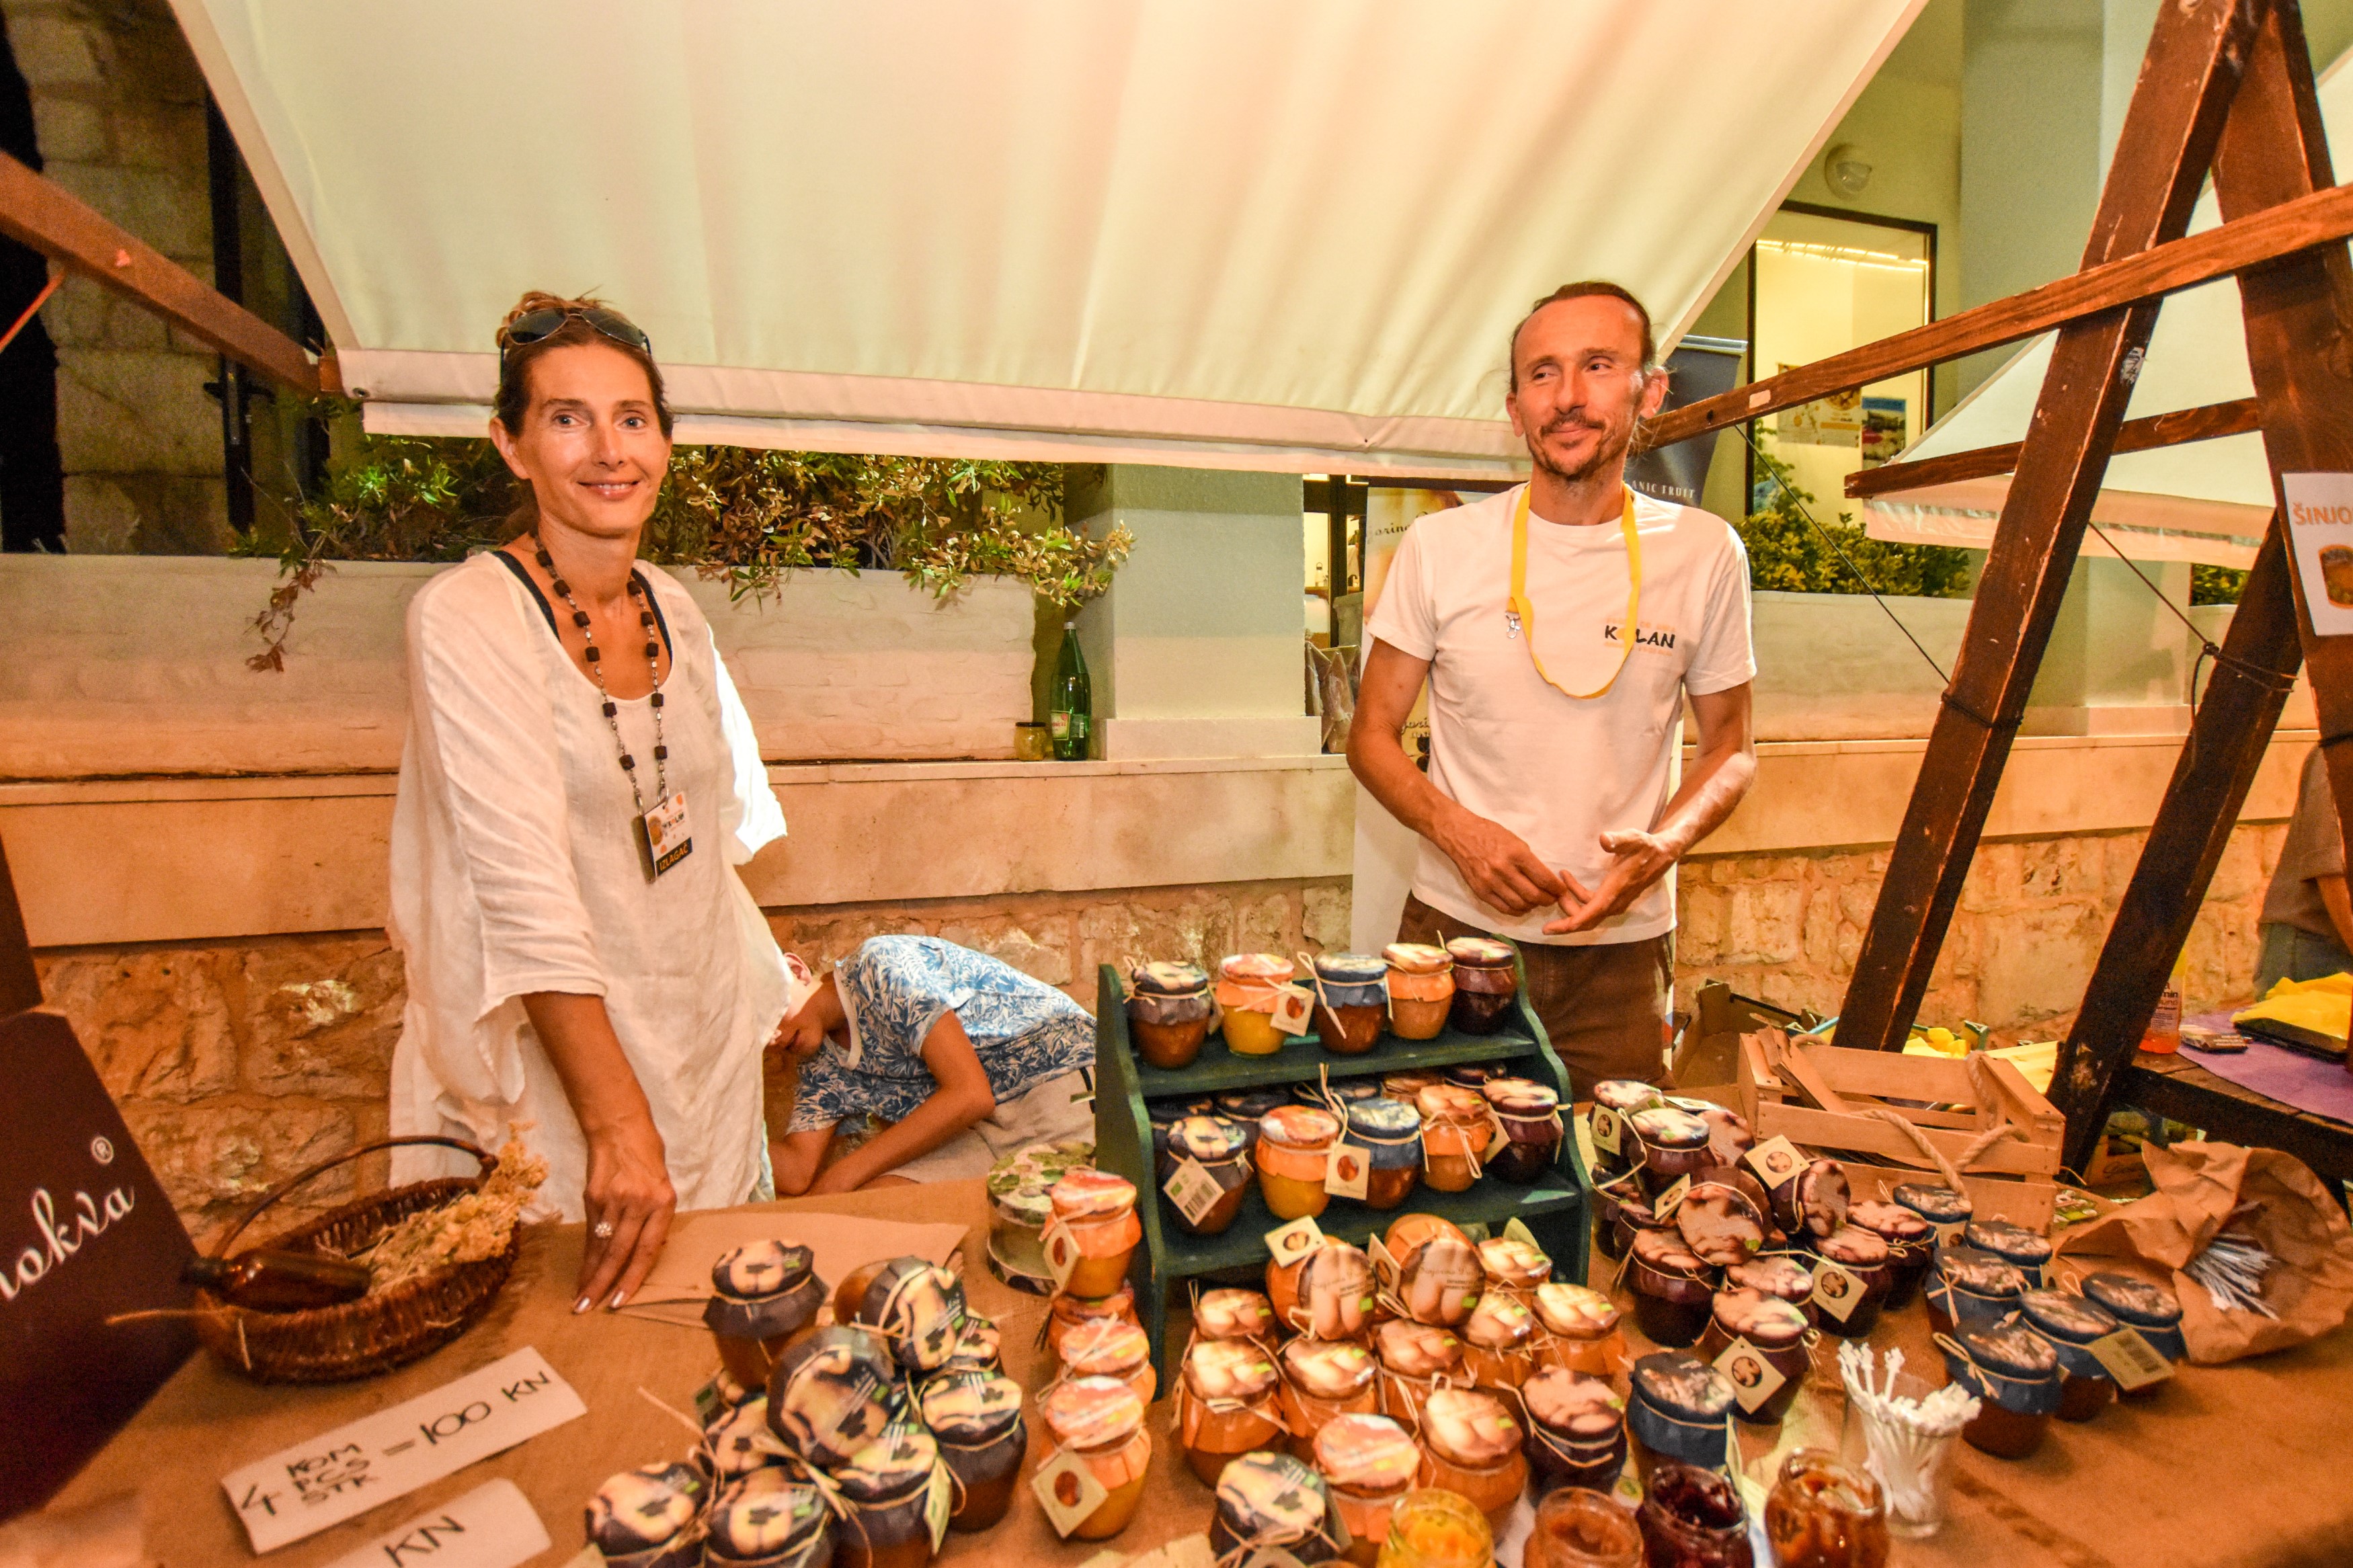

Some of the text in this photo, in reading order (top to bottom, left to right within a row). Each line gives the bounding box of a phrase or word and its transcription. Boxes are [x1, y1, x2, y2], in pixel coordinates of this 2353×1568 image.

[1662, 485, 1696, 498] FRUIT
[660, 842, 689, 871] IZLAGAČ
[241, 1483, 283, 1516] 4
[286, 1442, 362, 1478] KOM
[419, 1401, 491, 1445] 100
[501, 1370, 551, 1402] KN
[293, 1458, 370, 1492] PCS
[384, 1514, 466, 1568] KN
